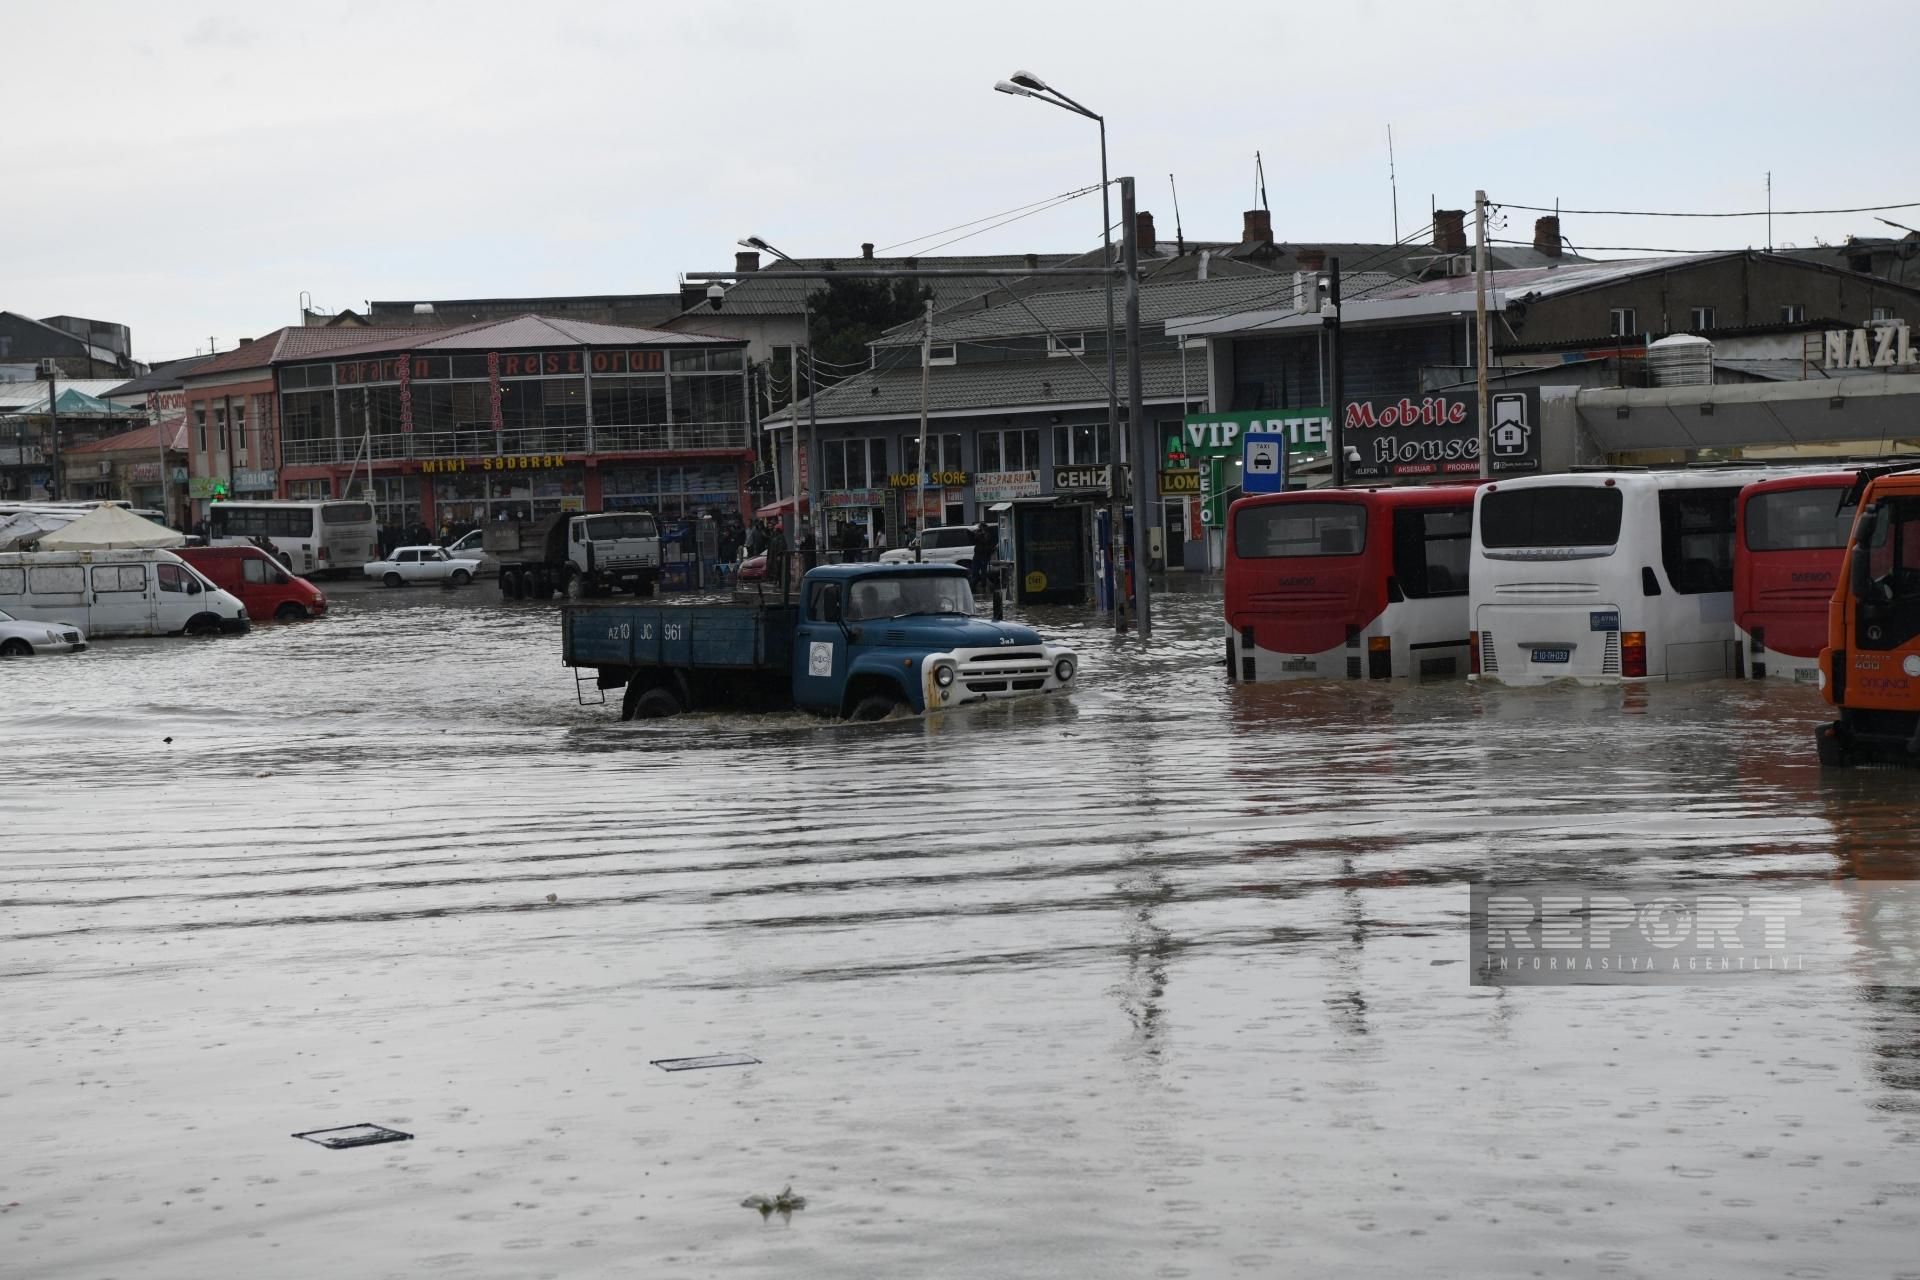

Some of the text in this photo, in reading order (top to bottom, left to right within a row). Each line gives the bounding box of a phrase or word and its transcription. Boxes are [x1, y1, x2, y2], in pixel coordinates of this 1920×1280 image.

[1344, 397, 1467, 429] Mobile
[1187, 421, 1240, 448] VIP
[1373, 434, 1480, 463] House
[1397, 464, 1431, 473] AKSESUAR
[1200, 462, 1213, 522] DEPO
[664, 623, 681, 640] 961
